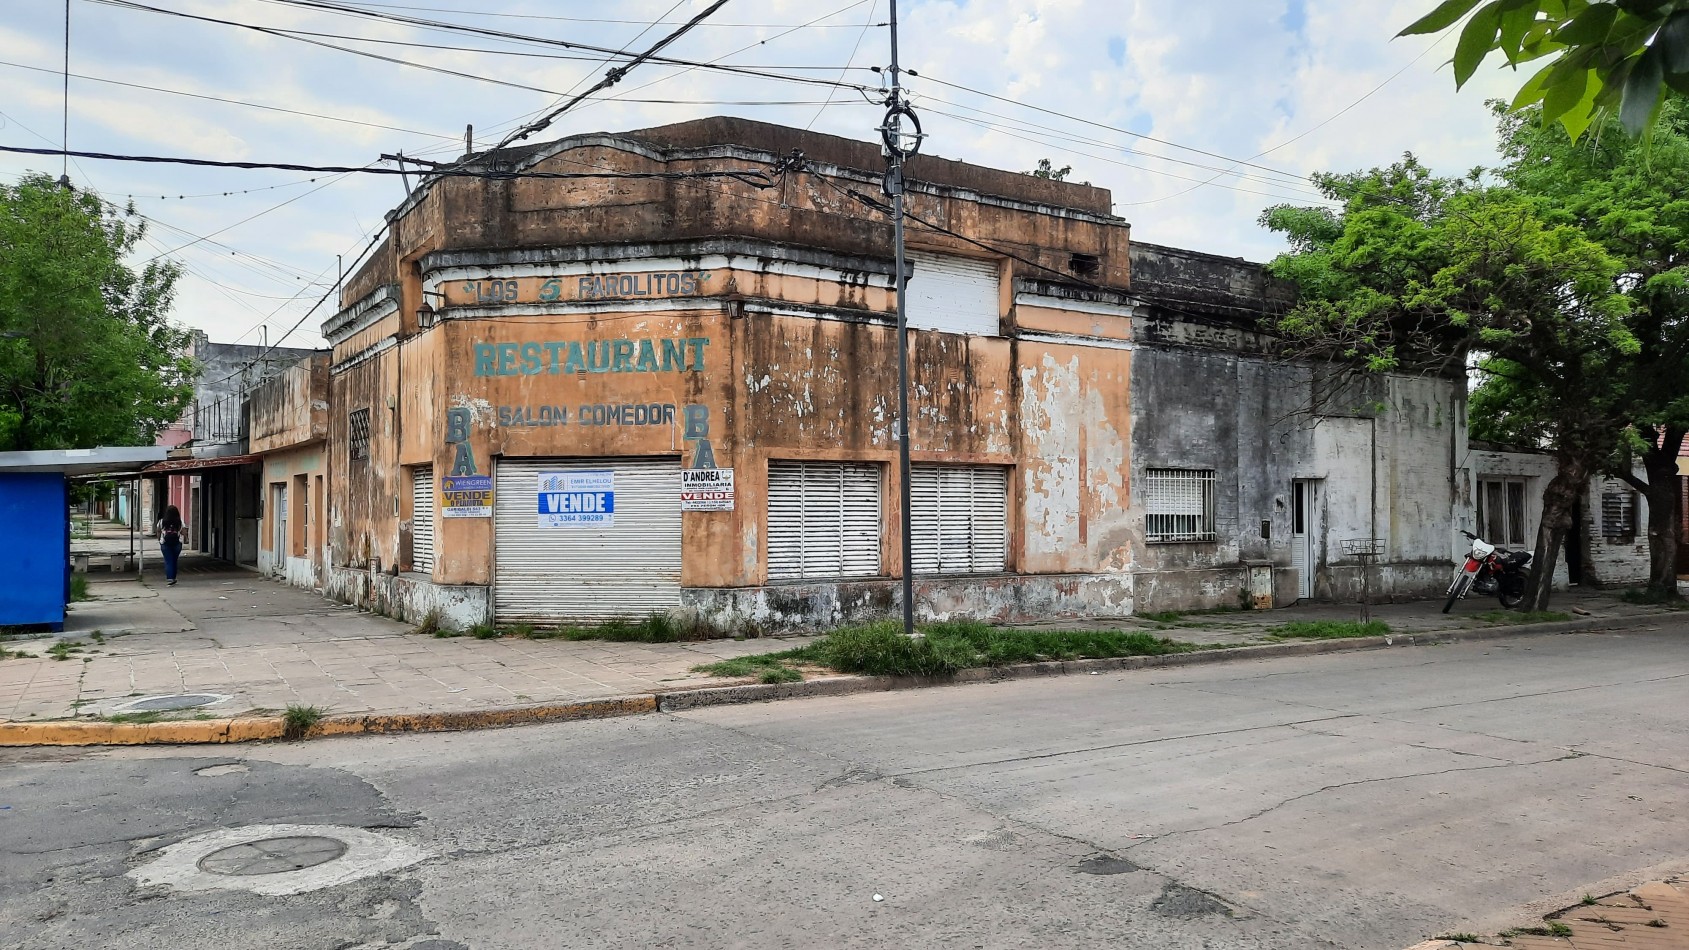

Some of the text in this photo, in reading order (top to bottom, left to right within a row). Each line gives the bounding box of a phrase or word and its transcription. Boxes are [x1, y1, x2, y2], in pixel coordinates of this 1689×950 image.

[473, 337, 710, 377] RESTAURANT
[499, 404, 675, 427] SALON COMEDOR
[444, 491, 491, 500] VENDE
[546, 493, 606, 512] VENDE
[682, 492, 734, 500] VENDE
[578, 514, 604, 522] 399289
